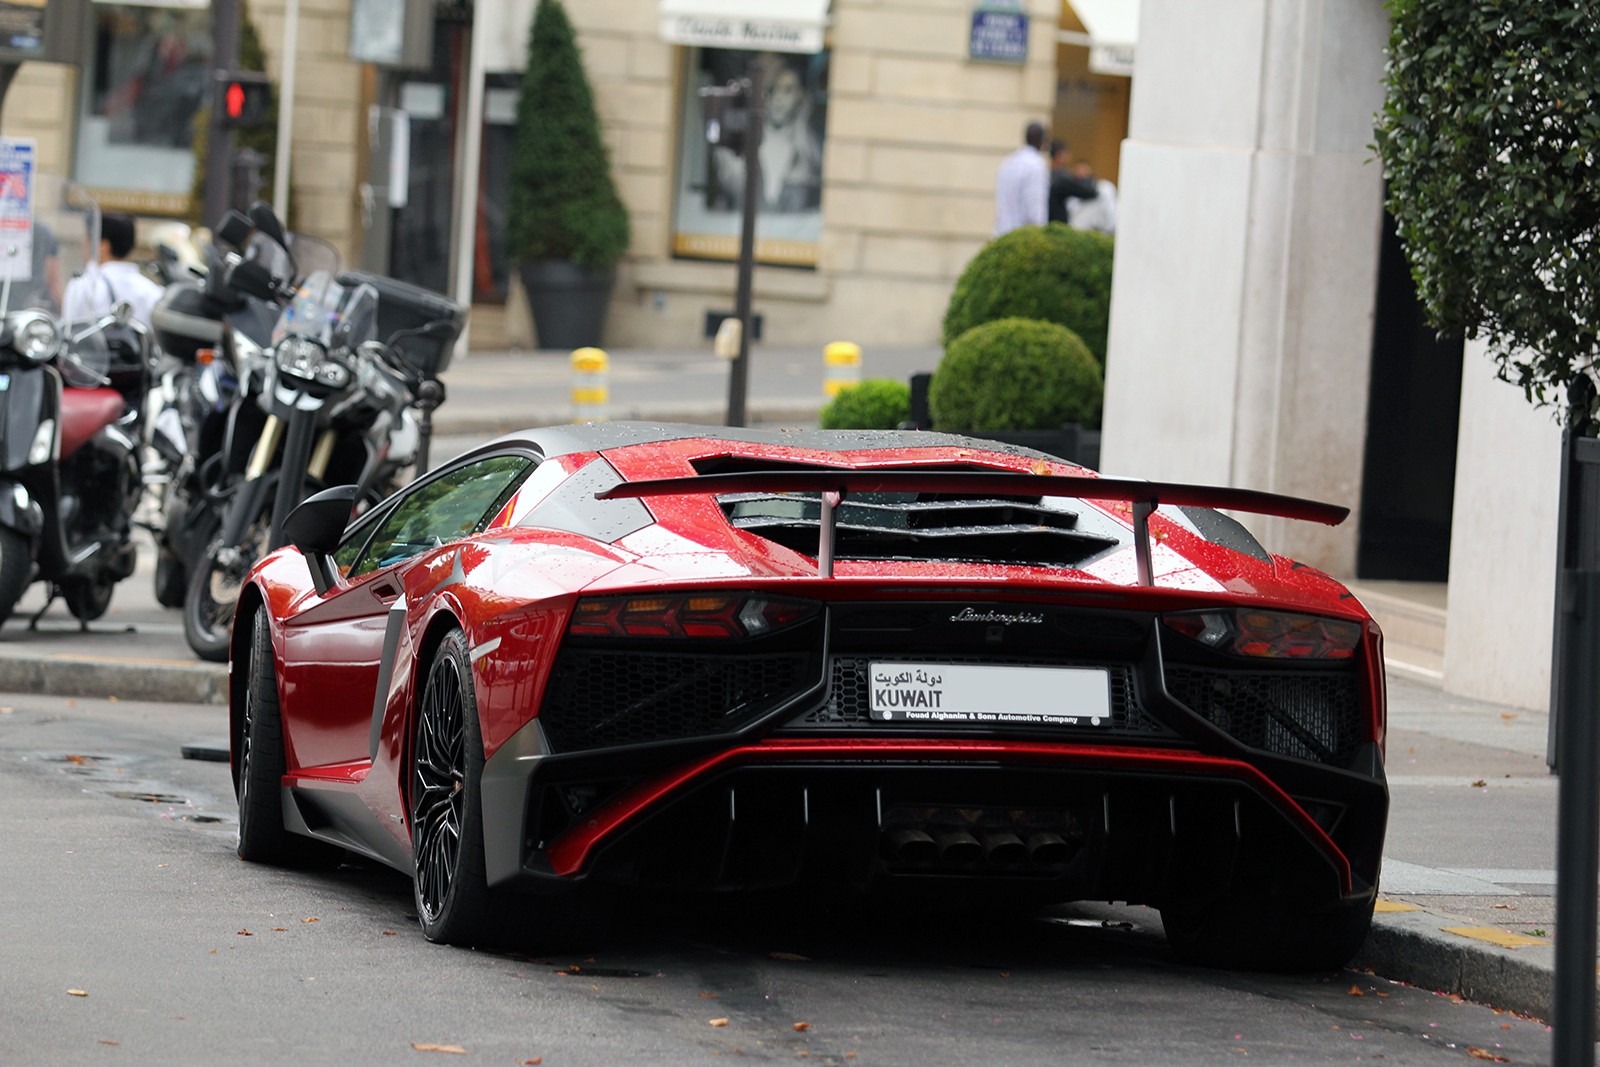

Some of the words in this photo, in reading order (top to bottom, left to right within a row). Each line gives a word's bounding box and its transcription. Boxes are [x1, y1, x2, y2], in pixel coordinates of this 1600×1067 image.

[949, 606, 1044, 626] Lamborghini
[875, 672, 912, 687] الكويت
[916, 669, 942, 687] دولة
[875, 689, 942, 708] KUWAIT
[906, 711, 930, 719] Fouad
[931, 712, 967, 721] Alghanim
[998, 713, 1041, 722] Automotive
[1042, 715, 1078, 725] Company
